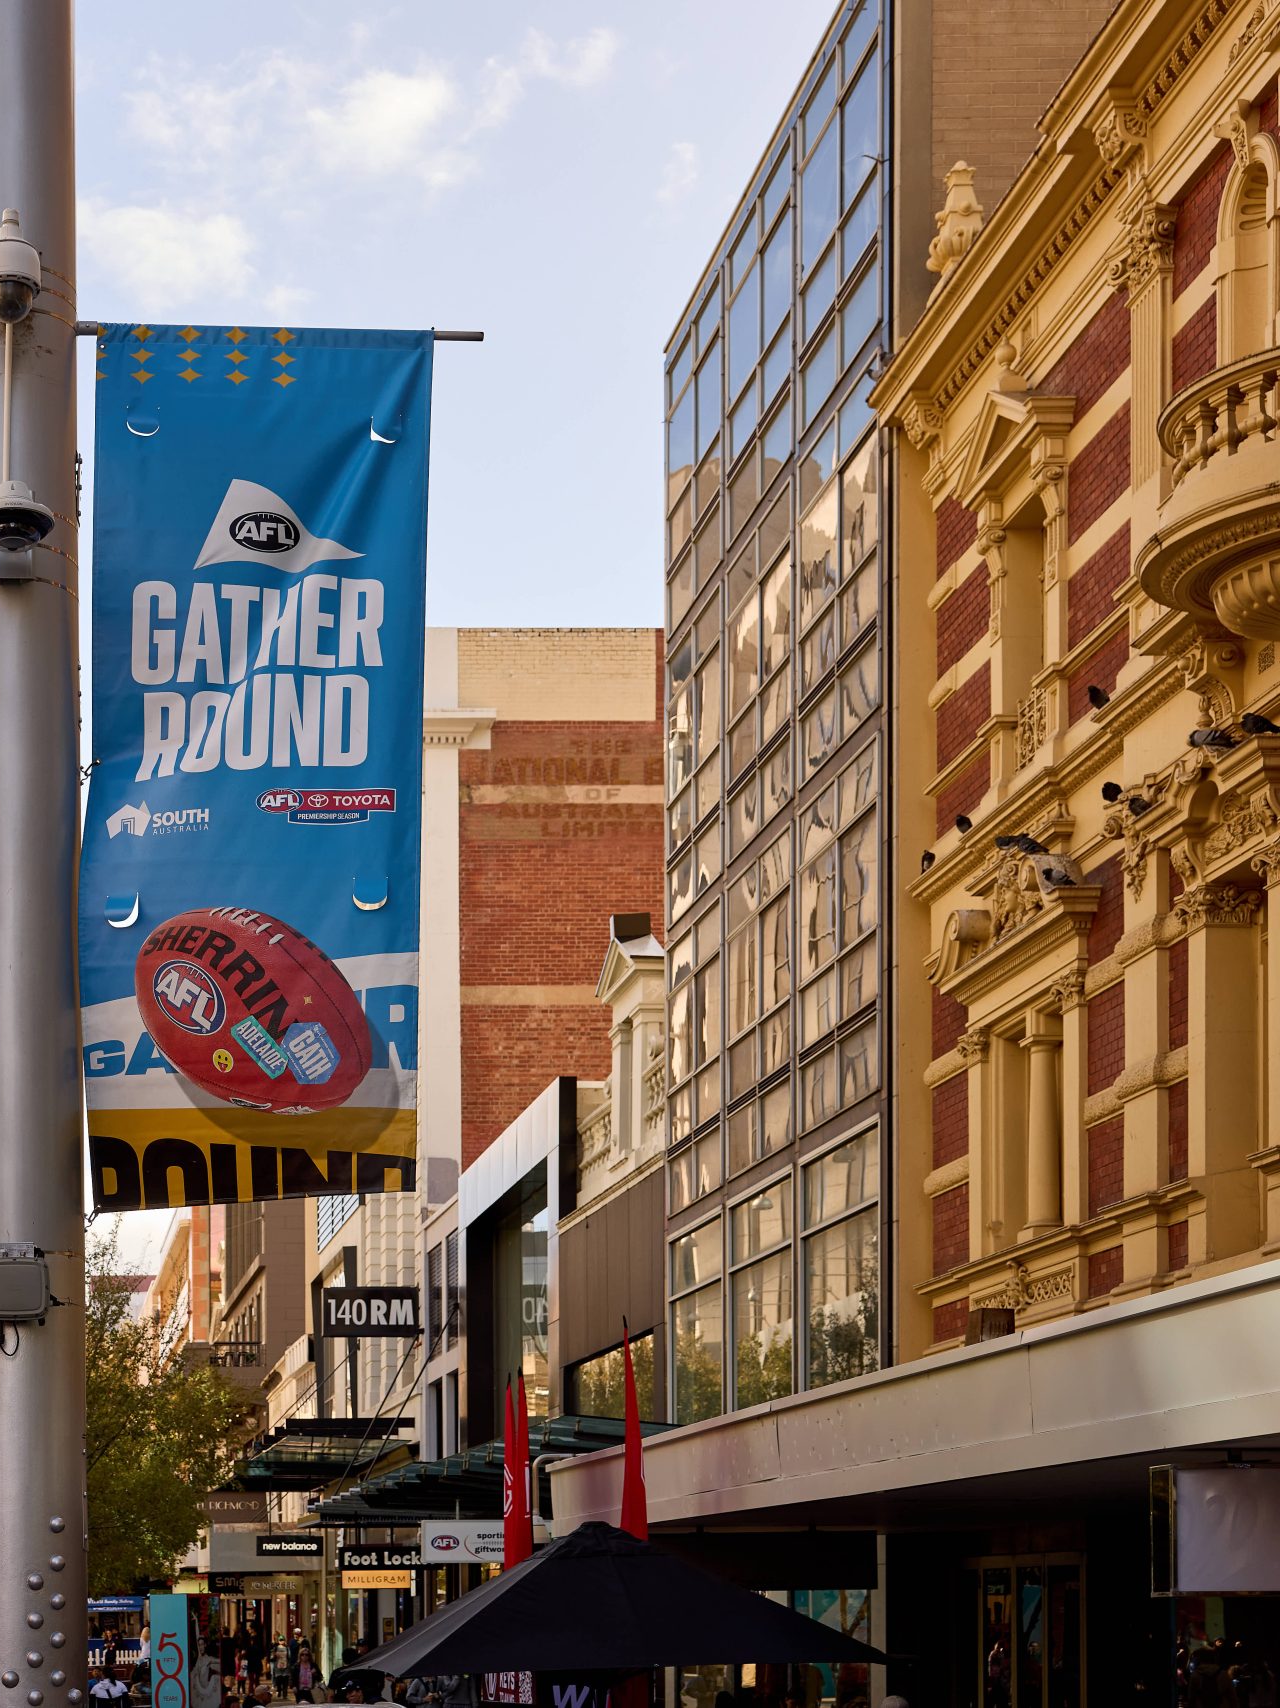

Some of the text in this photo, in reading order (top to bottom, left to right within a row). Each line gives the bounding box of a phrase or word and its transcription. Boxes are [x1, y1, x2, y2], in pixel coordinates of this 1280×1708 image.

[235, 520, 294, 545] AFL
[131, 573, 385, 686] GATHER
[134, 673, 370, 783] ROUND
[260, 793, 391, 807] AFL TOYOTA
[585, 788, 621, 801] OF
[152, 808, 209, 828] SOUTH
[152, 823, 209, 836] AUSTRALIA
[143, 925, 301, 1041] SHERRIN
[155, 969, 211, 1031] AFL
[236, 1020, 287, 1070] ADELAIDE
[288, 1030, 332, 1080] GATH
[327, 1298, 415, 1326] 140RM
[209, 1501, 260, 1511] RICHMOND
[262, 1542, 318, 1551] new balance
[433, 1538, 459, 1549] AFL
[344, 1551, 379, 1566] Foot
[263, 1581, 297, 1590] MERCER
[347, 1575, 406, 1584] MILLIGRAM
